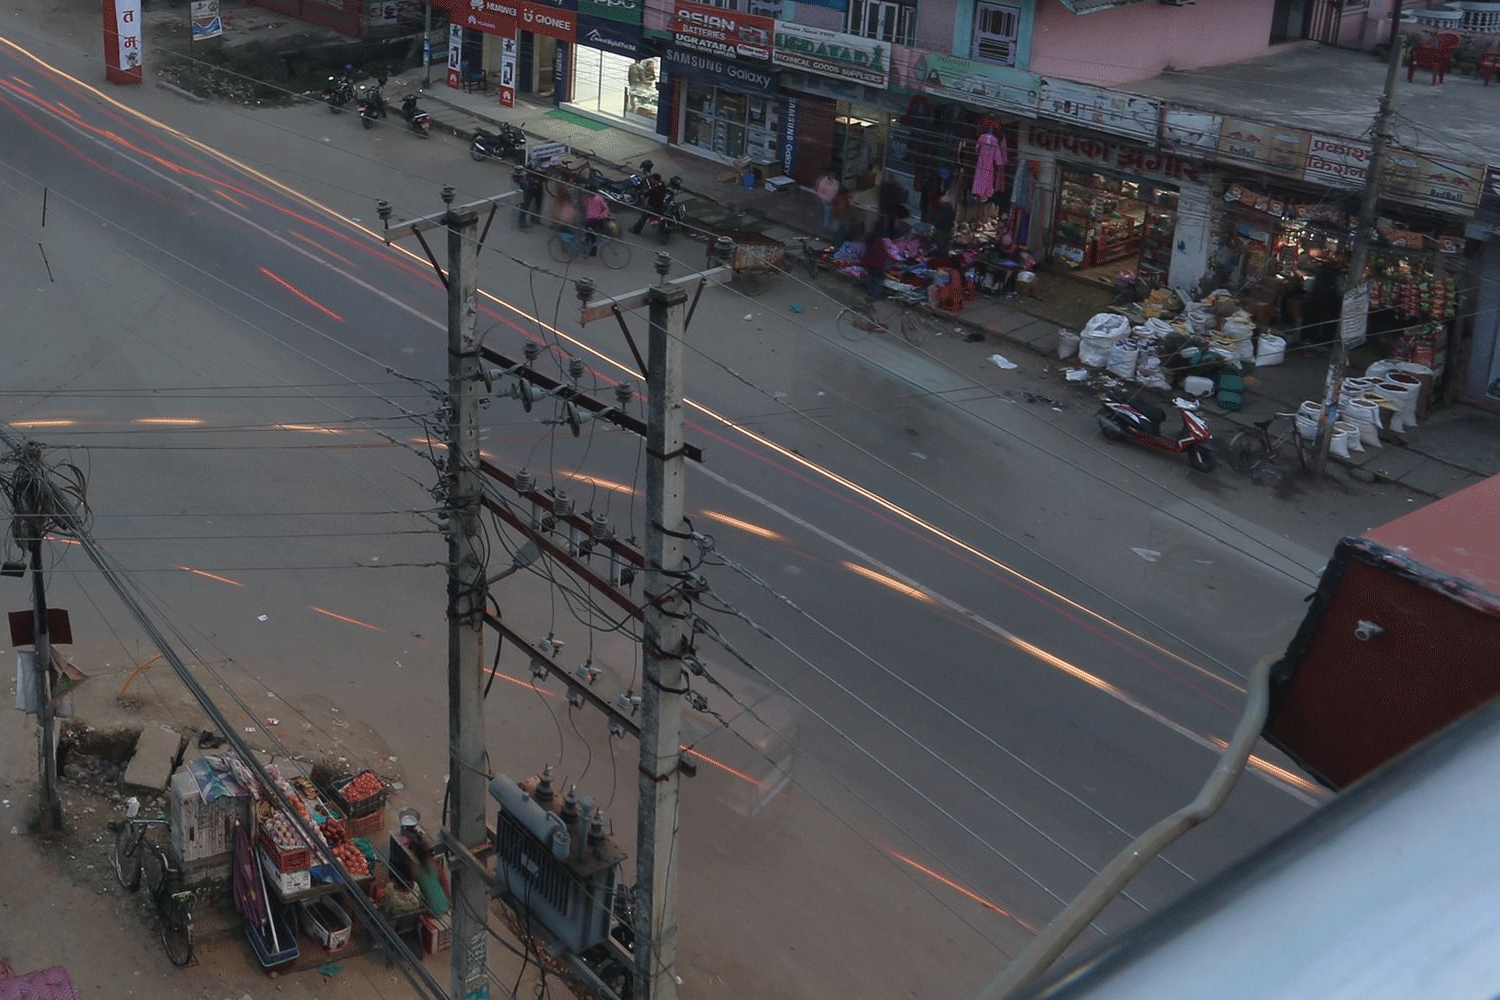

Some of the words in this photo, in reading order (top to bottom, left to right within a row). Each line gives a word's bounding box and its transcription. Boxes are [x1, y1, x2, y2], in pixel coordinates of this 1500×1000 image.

[535, 14, 571, 31] GIONEE
[682, 24, 726, 41] BATTERIES
[676, 33, 736, 54] UGRATARA
[666, 49, 722, 73] SAMSUNG
[727, 65, 771, 89] Galaxy
[813, 61, 840, 73] GOODS
[841, 68, 885, 84] SUPPLIERS
